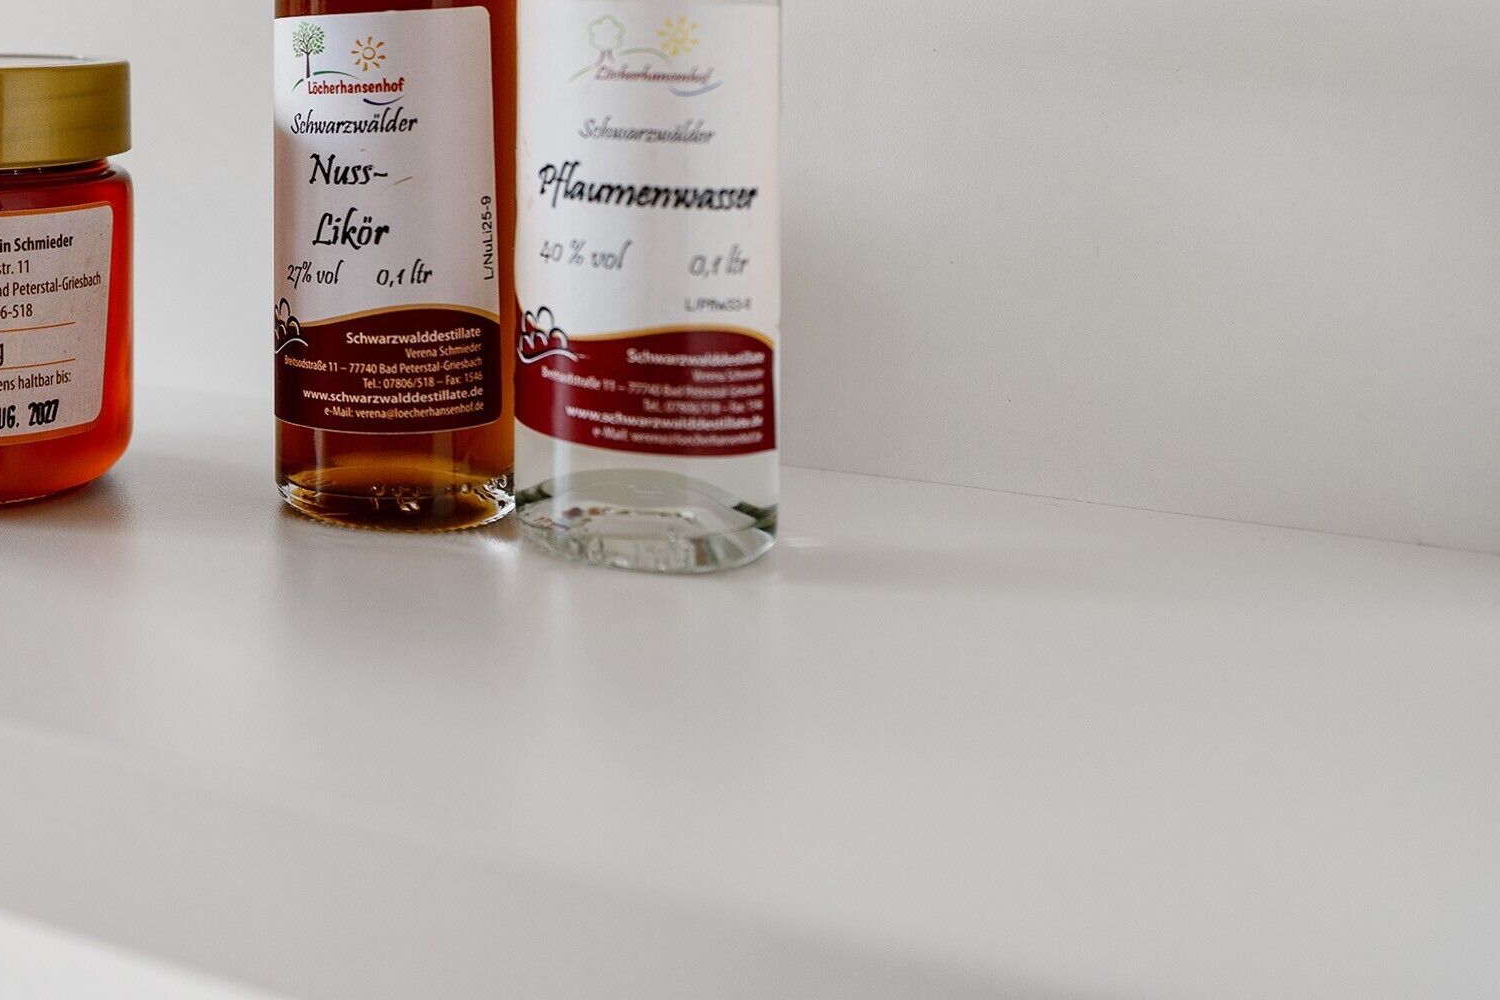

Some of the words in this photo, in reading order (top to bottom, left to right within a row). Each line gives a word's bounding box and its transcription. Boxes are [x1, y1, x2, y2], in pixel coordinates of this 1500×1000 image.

[308, 77, 405, 95] Löcherhansenhof
[290, 106, 418, 134] Schwarzwälder
[309, 153, 388, 185] Nuss-
[538, 160, 758, 210] Pflaumenwasser
[312, 207, 390, 250] Likör
[481, 195, 494, 281] L/NuLi25-9
[14, 233, 73, 252] Schmieder
[591, 240, 632, 270] vol
[18, 260, 30, 273] 11
[317, 259, 344, 285] vol
[376, 268, 405, 288] 0,1
[411, 258, 433, 284] ltr
[12, 271, 101, 296] Peterstal-Griesbach
[346, 327, 481, 345] Schwarzwalddestillate
[404, 348, 438, 359] Verena
[329, 362, 338, 372] 11
[349, 363, 377, 374] 77740
[379, 364, 398, 375] Bad
[17, 373, 54, 391] haltbar
[55, 370, 72, 385] bis:
[383, 377, 435, 389] 07806/518
[303, 387, 484, 404] www.schwarzwalddestillate.de
[324, 406, 354, 418] e-Mail:
